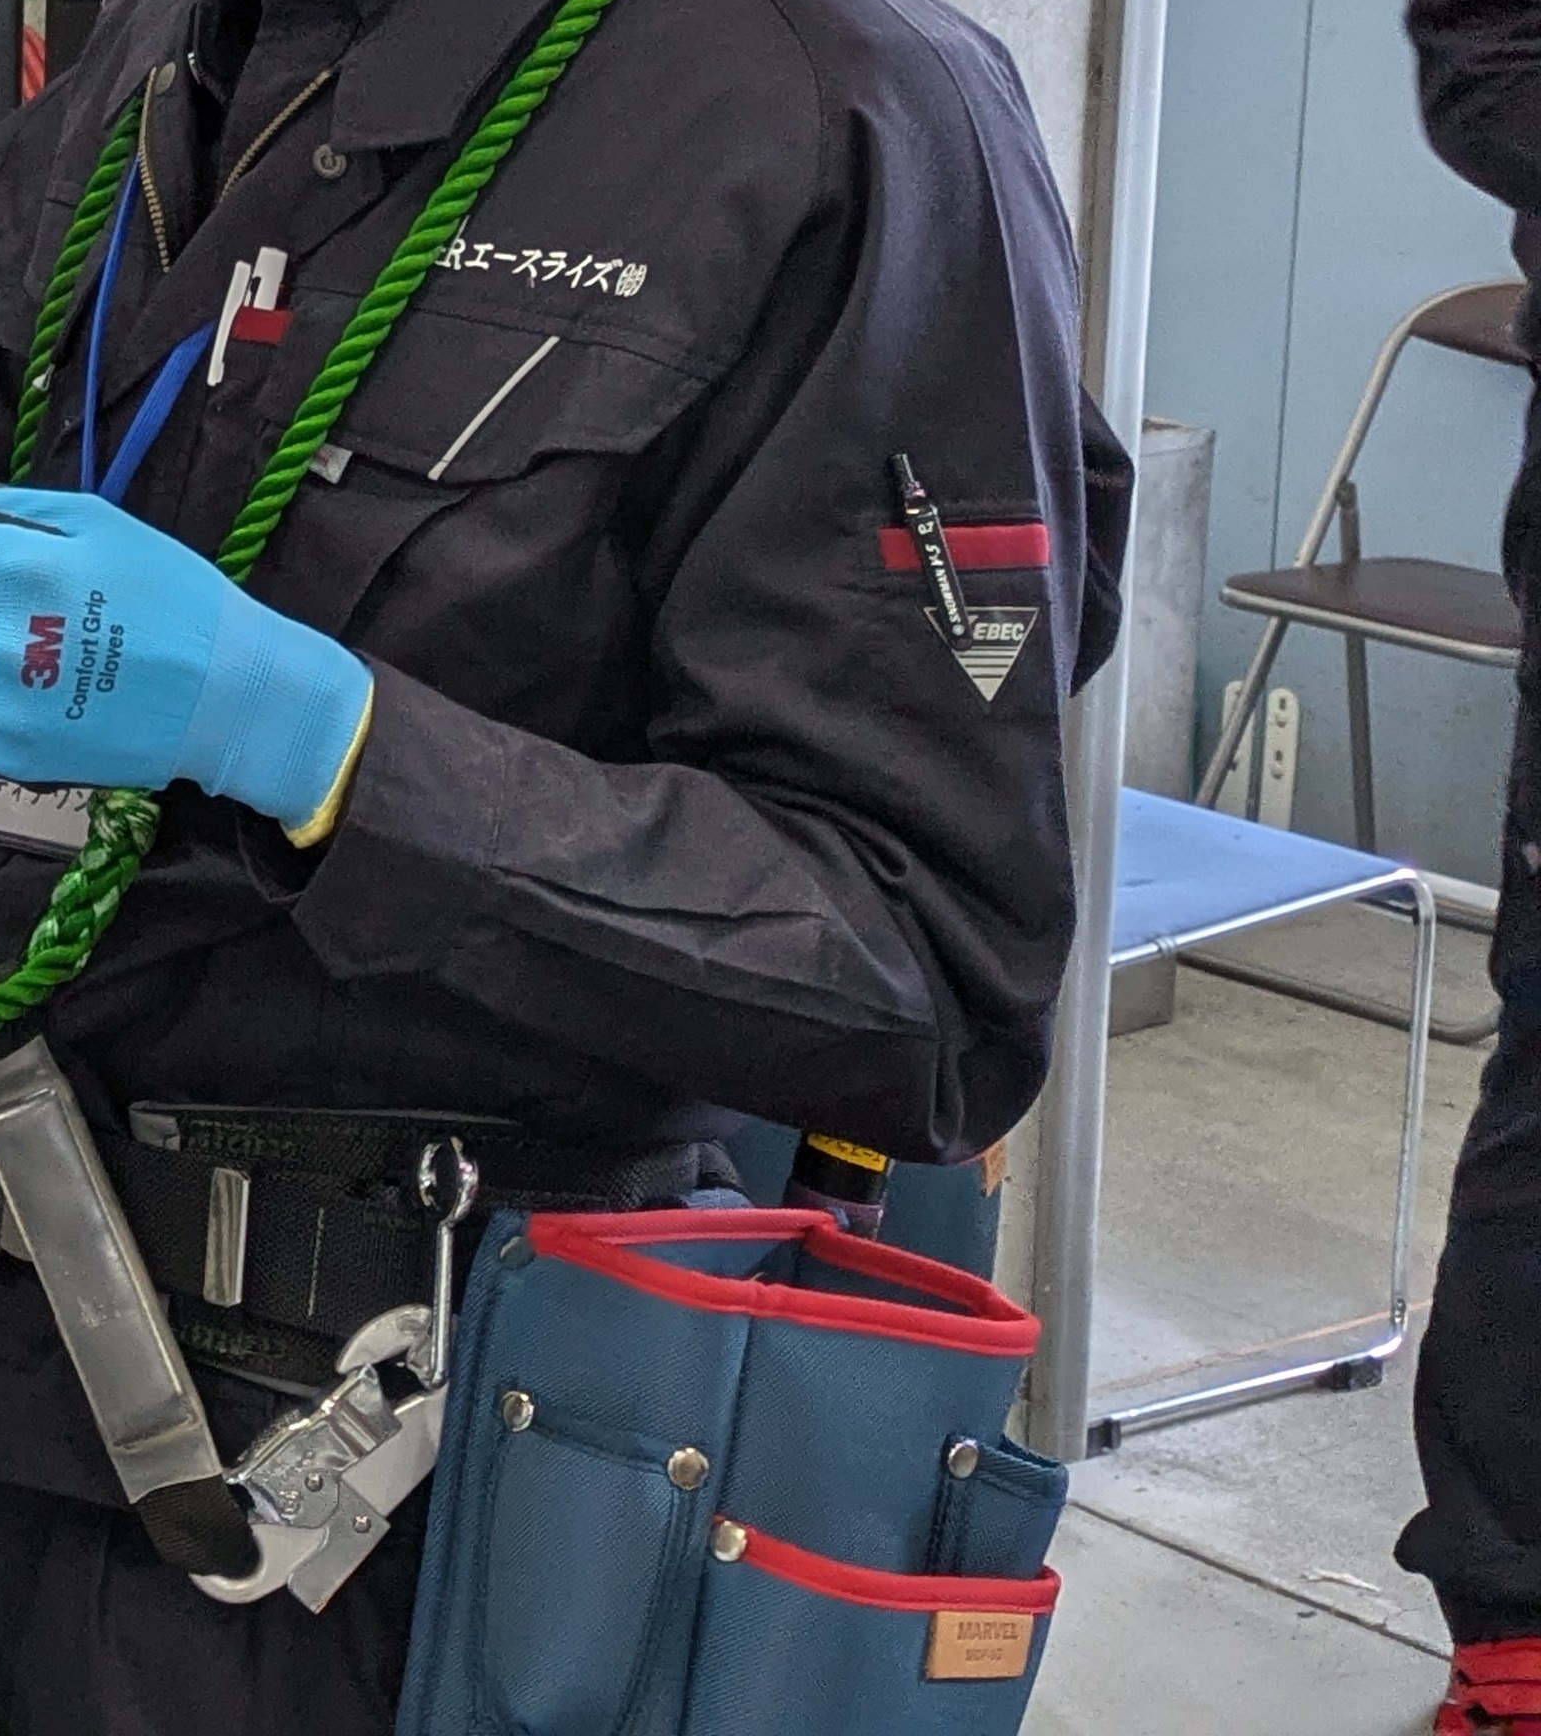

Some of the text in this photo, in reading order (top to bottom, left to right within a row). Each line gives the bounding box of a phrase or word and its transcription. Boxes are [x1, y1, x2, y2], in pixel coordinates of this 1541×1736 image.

[21, 614, 66, 690] 3M
[65, 590, 108, 720] Comfort Grip
[96, 624, 125, 693] Gloves
